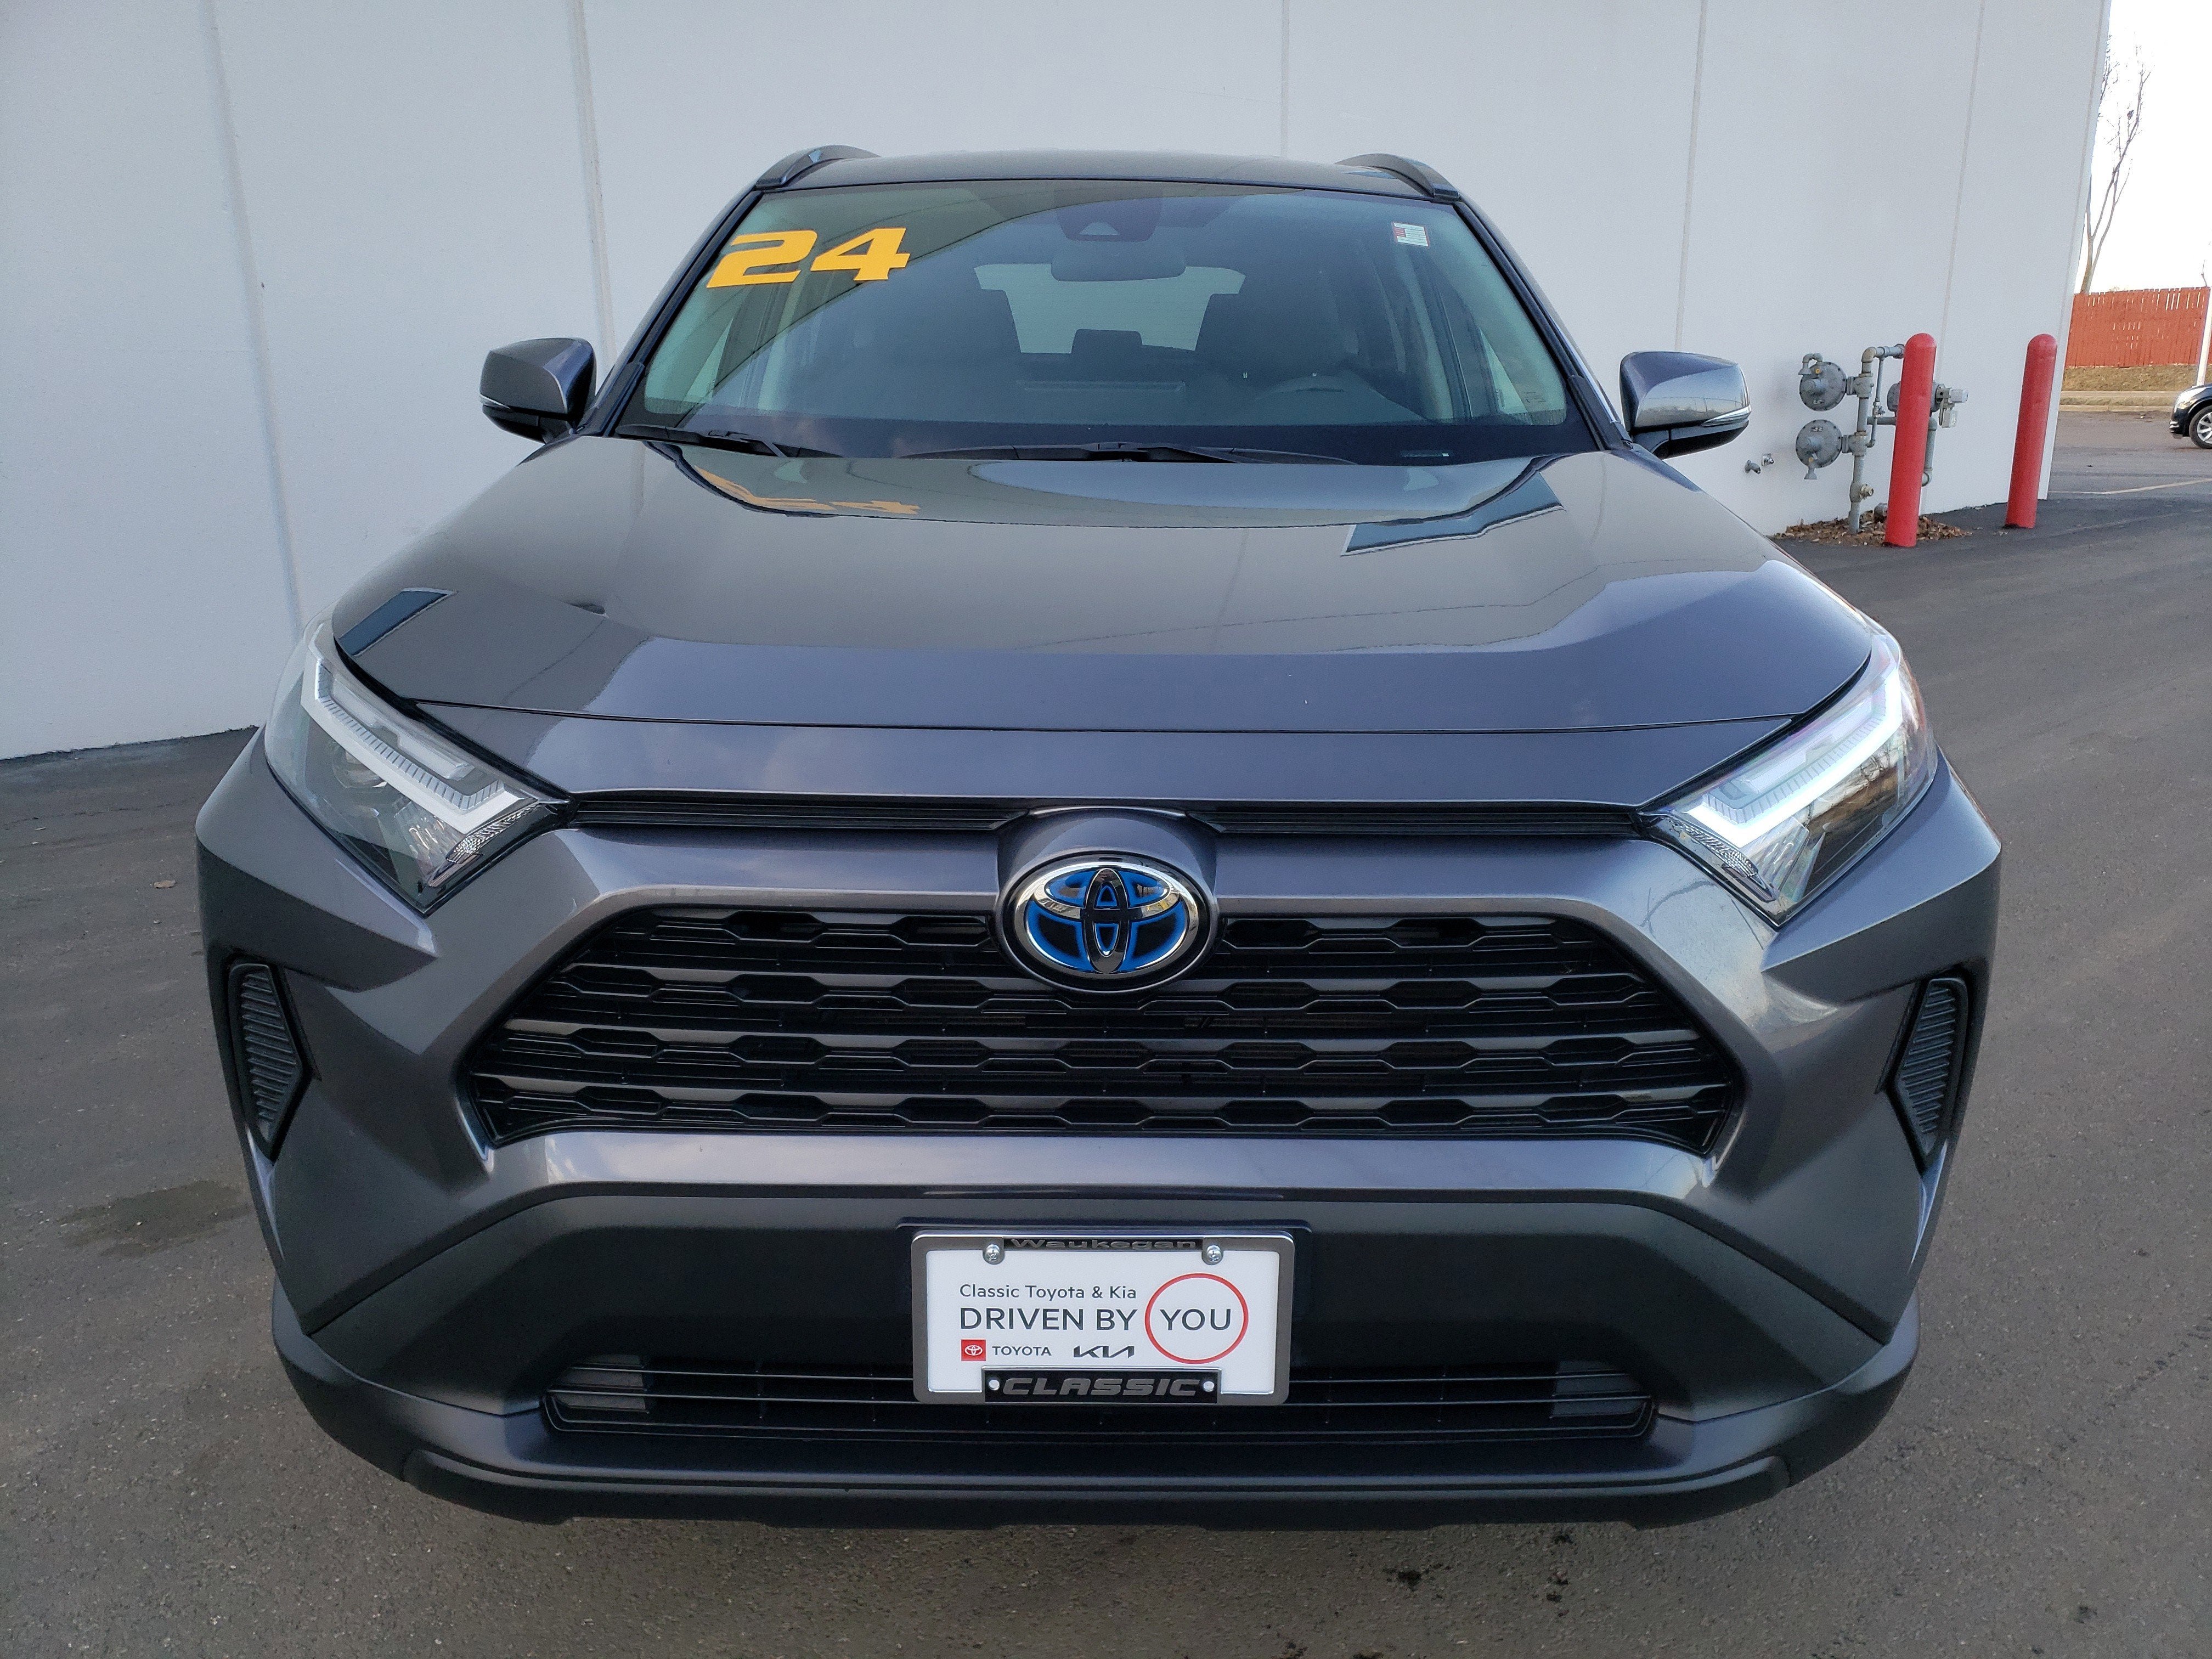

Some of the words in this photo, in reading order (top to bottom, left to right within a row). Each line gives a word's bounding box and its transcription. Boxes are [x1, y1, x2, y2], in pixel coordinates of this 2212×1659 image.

[706, 227, 911, 288] 24
[1011, 1239, 1197, 1250] Waukegan
[960, 1284, 1019, 1297] Classic
[1025, 1285, 1085, 1301] Toyota
[1092, 1286, 1103, 1299] &
[1110, 1285, 1136, 1299] Kia
[960, 1307, 1084, 1330] DRIVEN
[1097, 1308, 1138, 1331] BY
[1160, 1308, 1232, 1331] YOU
[992, 1346, 1052, 1356] TOYOTA
[1003, 1378, 1200, 1396] CLASSIC
